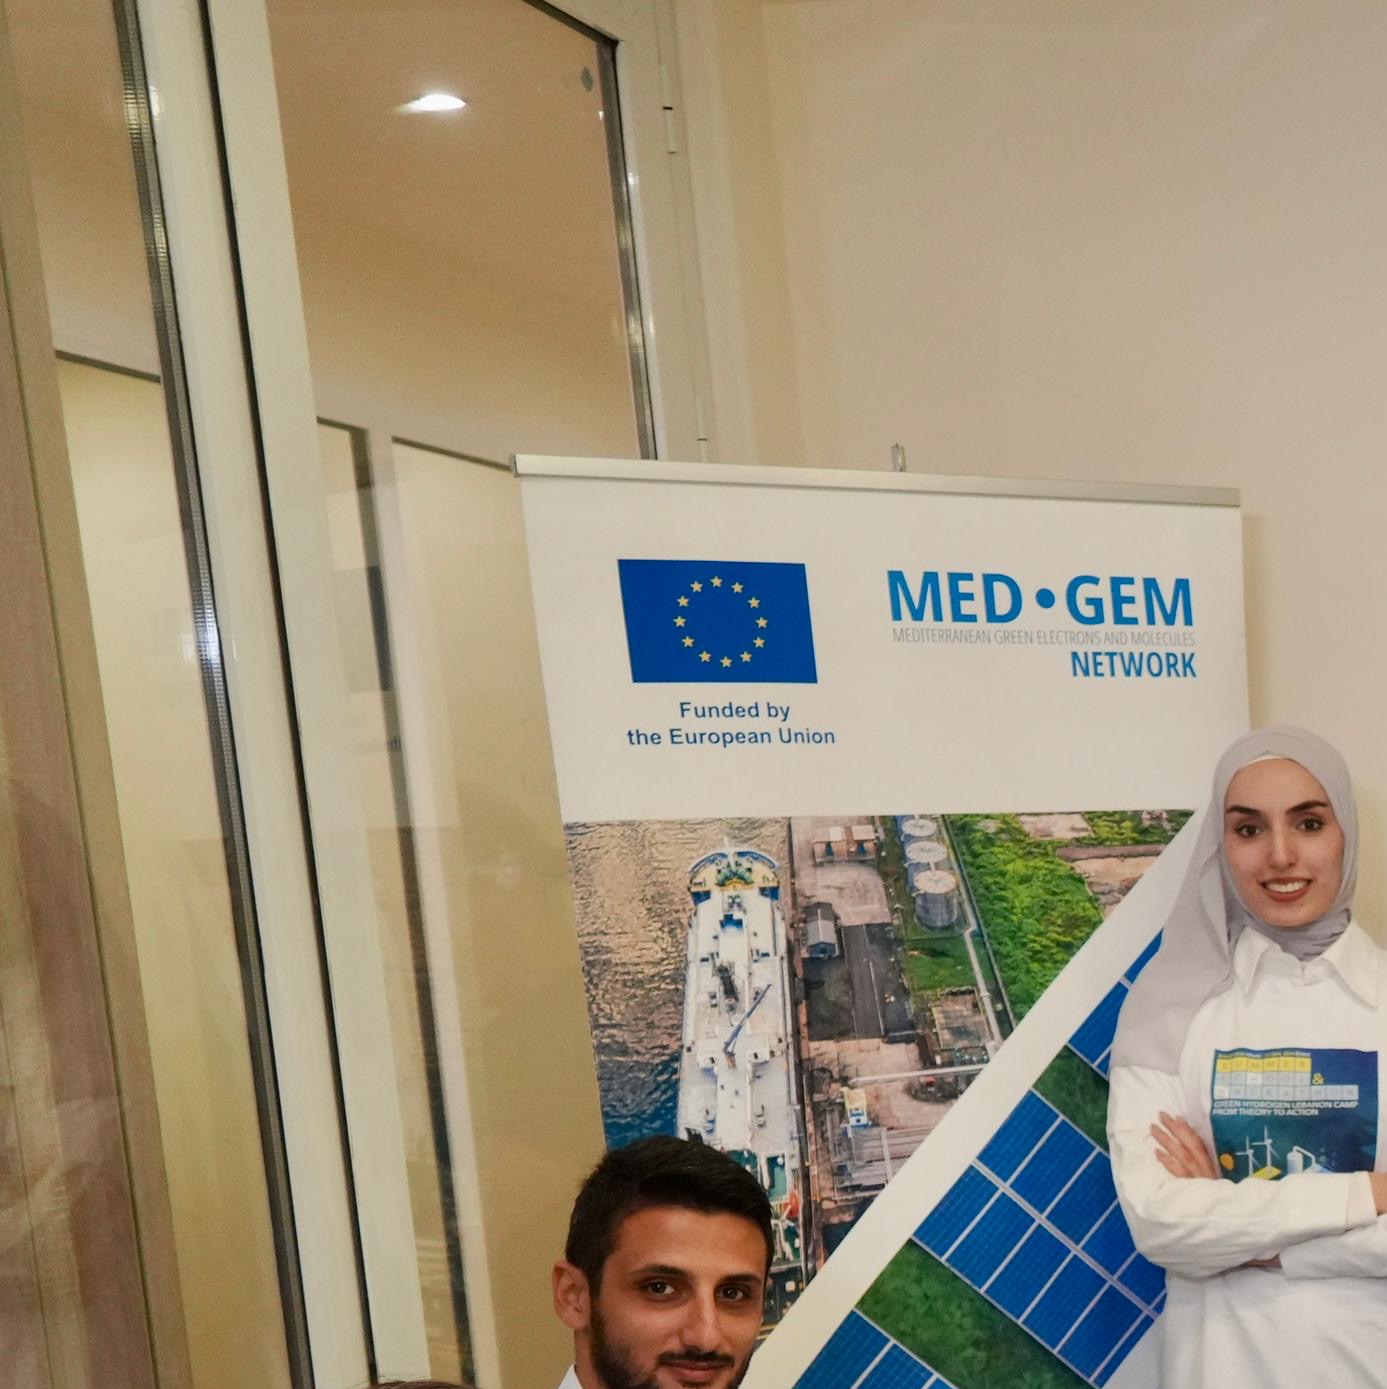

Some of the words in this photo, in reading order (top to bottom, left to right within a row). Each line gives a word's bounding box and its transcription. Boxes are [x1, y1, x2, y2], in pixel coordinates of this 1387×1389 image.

[891, 627, 992, 645] MEDITERRANEAN
[994, 629, 1034, 645] GREEN
[1036, 630, 1102, 646] ELECTRONS
[1103, 631, 1128, 646] AND
[1130, 631, 1197, 647] MOLECULES
[1070, 651, 1197, 678] NETWORK
[679, 701, 760, 719] Funded
[766, 702, 791, 722] by
[627, 729, 662, 745] the
[670, 728, 772, 748] European
[779, 727, 836, 744] Union
[1312, 1072, 1324, 1085] &
[1213, 1108, 1239, 1116] FROM
[1239, 1108, 1273, 1116] THEORY
[1273, 1108, 1286, 1116] TO
[1286, 1108, 1320, 1116] ACTION
[1214, 1100, 1242, 1108] GREEN
[1242, 1100, 1291, 1109] HYDROGEN
[1291, 1101, 1333, 1109] LEBANON
[1333, 1101, 1359, 1109] CAMP
